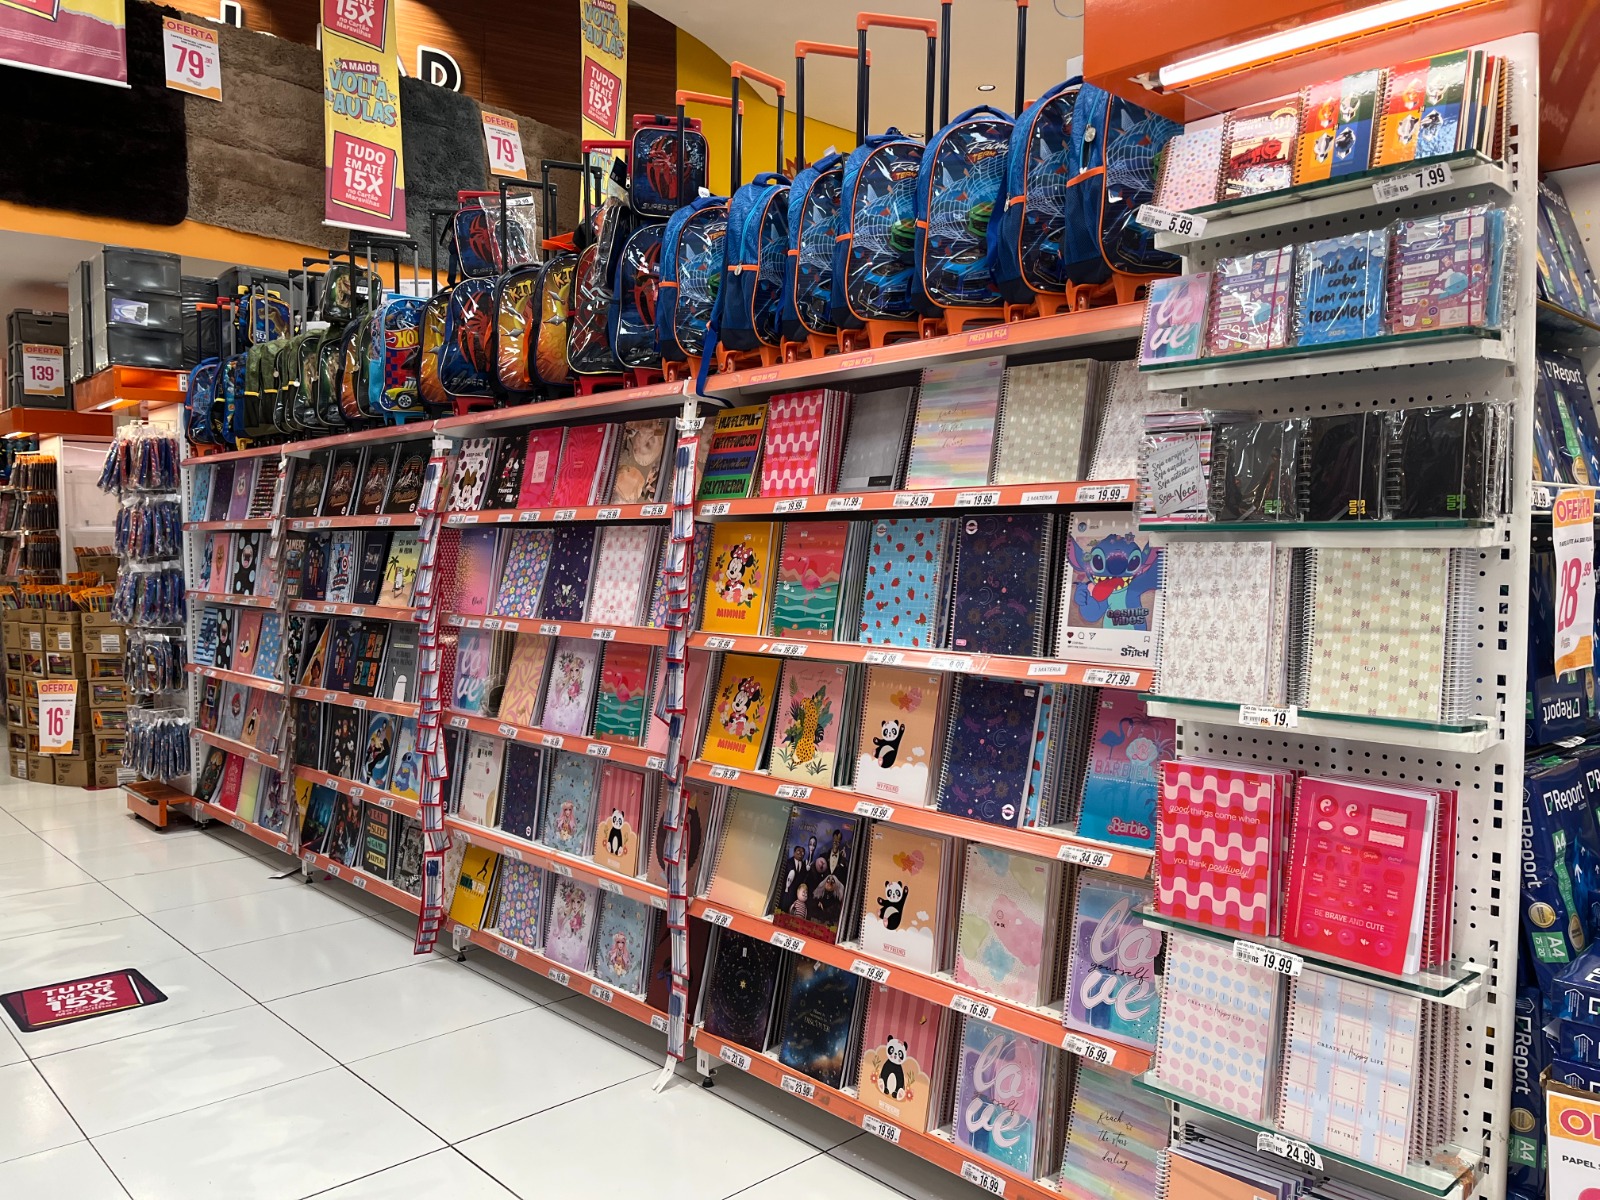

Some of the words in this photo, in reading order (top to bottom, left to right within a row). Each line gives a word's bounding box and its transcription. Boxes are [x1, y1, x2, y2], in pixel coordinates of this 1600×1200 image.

[336, 0, 375, 28] 15X
[339, 16, 349, 26] no
[349, 18, 371, 32] Cartão
[584, 3, 620, 37] VOLTA
[166, 20, 214, 43] OFERTA
[336, 20, 372, 39] Maravilhas
[585, 27, 624, 60] AULAS
[172, 44, 206, 80] 79
[341, 61, 347, 69] A
[349, 62, 378, 73] MAIOR
[328, 68, 388, 102] VOLTA
[590, 65, 616, 90] TUDO
[590, 79, 601, 91] EM
[601, 83, 614, 100] ATÉ
[588, 87, 612, 117] 15X
[333, 99, 397, 127] AULAS
[484, 114, 517, 130] OFERTA
[345, 141, 387, 166] TUDO
[490, 135, 516, 164] 79
[972, 150, 999, 160] TEAM
[345, 157, 363, 170] EM
[363, 161, 384, 178] ATÉ
[344, 167, 384, 197] 15X
[345, 192, 381, 209] Maravilhas
[347, 188, 357, 197] no
[357, 190, 379, 202] Cartão
[25, 347, 60, 357] OFERTA
[582, 356, 615, 364] SUPER
[29, 366, 55, 382] 139
[1552, 361, 1583, 385] Report
[1152, 459, 1166, 473] Seja
[1153, 469, 1167, 482] Seja
[1157, 479, 1171, 492] Seja
[1158, 491, 1175, 505] Seja
[1557, 497, 1591, 522] OFERTA
[1557, 558, 1582, 633] 28
[716, 607, 747, 620] MINNIE
[41, 683, 74, 694] OFERTA
[46, 707, 64, 737] 16
[1543, 698, 1572, 725] Report
[716, 738, 747, 755] MINNIE
[1552, 781, 1585, 812] Report
[373, 811, 386, 822] EAT
[1168, 805, 1190, 815] good
[1190, 807, 1214, 819] things
[1214, 811, 1237, 822] come
[1238, 815, 1261, 826] when
[371, 825, 387, 838] SLEEP
[1111, 817, 1149, 837] Barbie
[1554, 833, 1567, 853] A4
[370, 853, 386, 867] REPEAT
[1173, 857, 1187, 866] you
[1188, 858, 1207, 868] think
[1520, 825, 1542, 890] Report
[1314, 908, 1323, 917] BE
[1324, 909, 1348, 923] BRAVE
[1349, 916, 1364, 927] AND
[1365, 920, 1386, 934] CUTE
[1547, 936, 1566, 958] A4
[1086, 961, 1150, 988] yourself
[42, 979, 114, 997] TUDO
[46, 992, 76, 1004] EM
[79, 985, 112, 998] ATÉ
[46, 990, 118, 1012] 15X
[1316, 1041, 1341, 1053] CREATE
[1369, 1057, 1386, 1067] LIFE
[1514, 1034, 1533, 1097] Report
[1326, 1126, 1343, 1137] STAY
[1343, 1131, 1361, 1143] TRUE
[1519, 1139, 1534, 1163] A4
[1562, 1155, 1596, 1170] PAPEL
